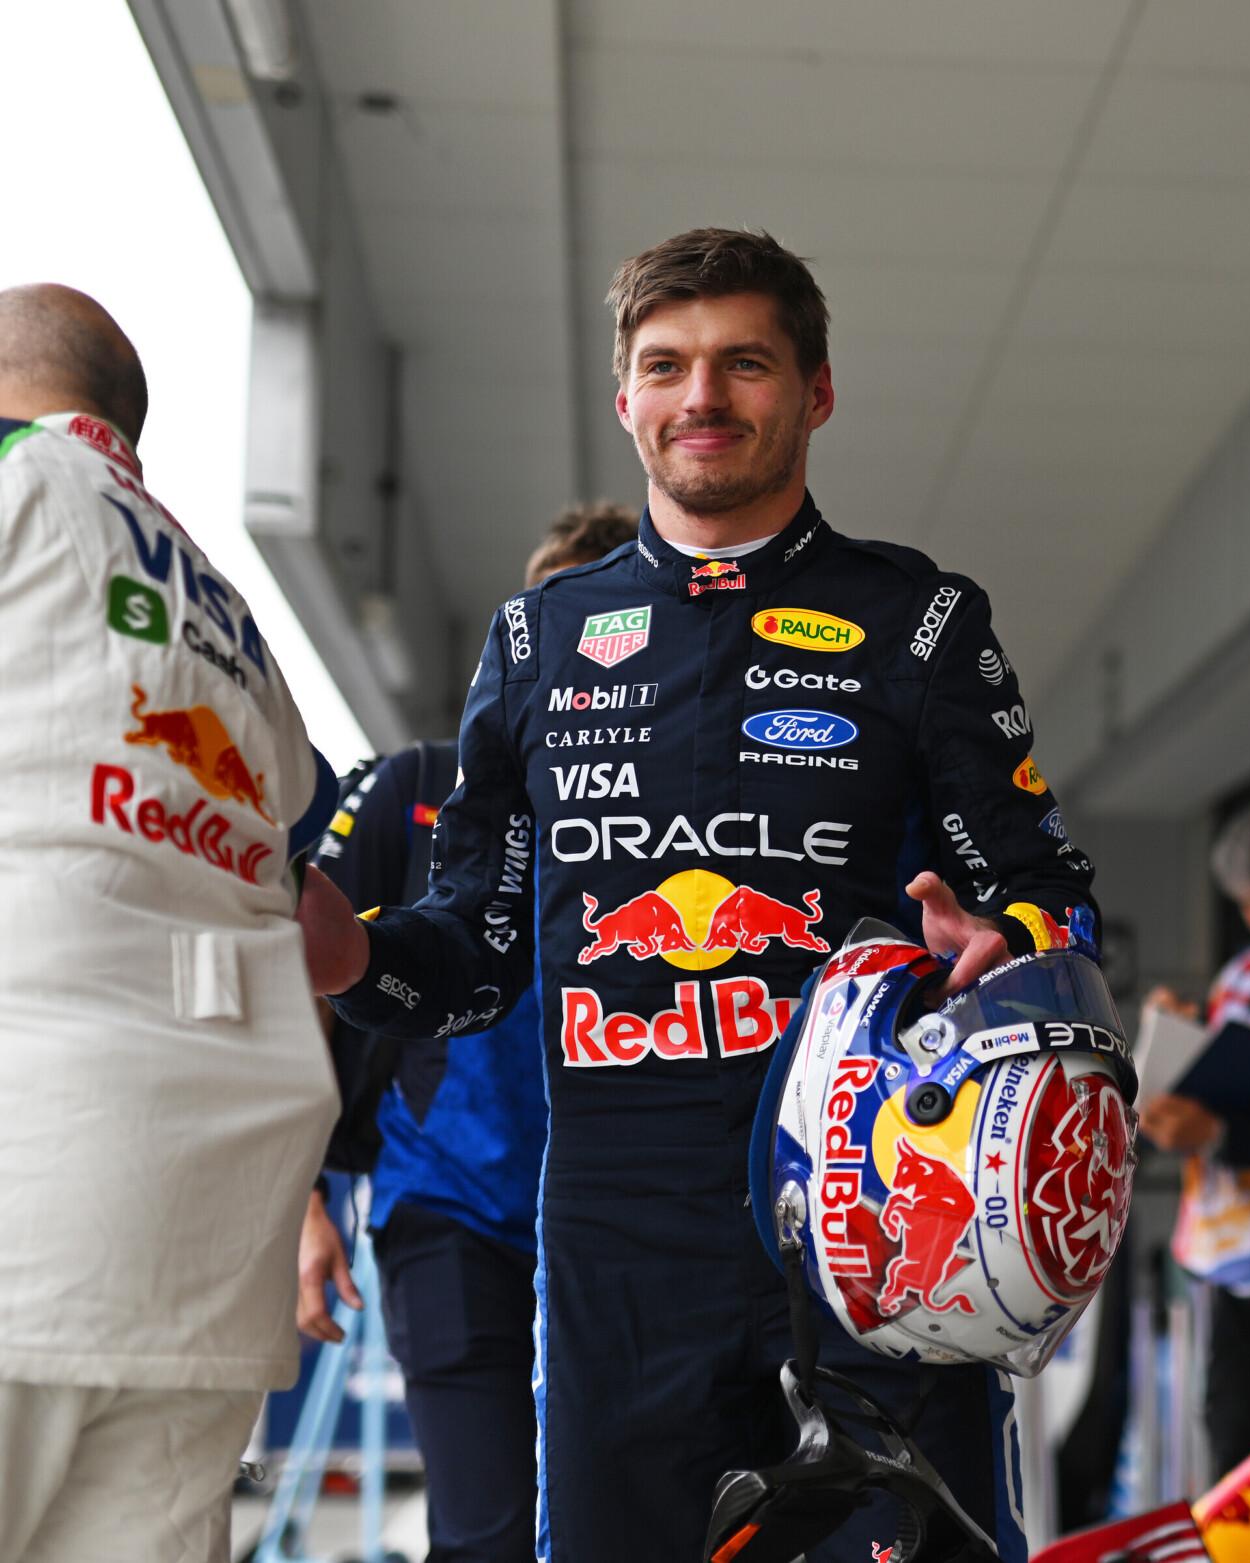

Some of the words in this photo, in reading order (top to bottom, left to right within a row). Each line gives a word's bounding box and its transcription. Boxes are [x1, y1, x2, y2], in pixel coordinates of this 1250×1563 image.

[101, 490, 267, 684] VISA
[717, 574, 746, 590] Bull
[590, 612, 644, 635] TAG
[780, 618, 851, 645] RAUCH
[909, 586, 962, 661] sparco
[582, 632, 645, 664] HEUER
[548, 685, 627, 711] Mobil
[545, 726, 652, 748] CARLYLE
[764, 714, 836, 744] Ford
[739, 751, 859, 770] RACING
[549, 762, 640, 800] VISA
[90, 763, 208, 857] Red
[551, 812, 853, 866] ORACLE
[561, 980, 708, 1067] Red
[710, 976, 802, 1059] Bu
[995, 1031, 1030, 1048] Mobil
[942, 1056, 975, 1087] VISA
